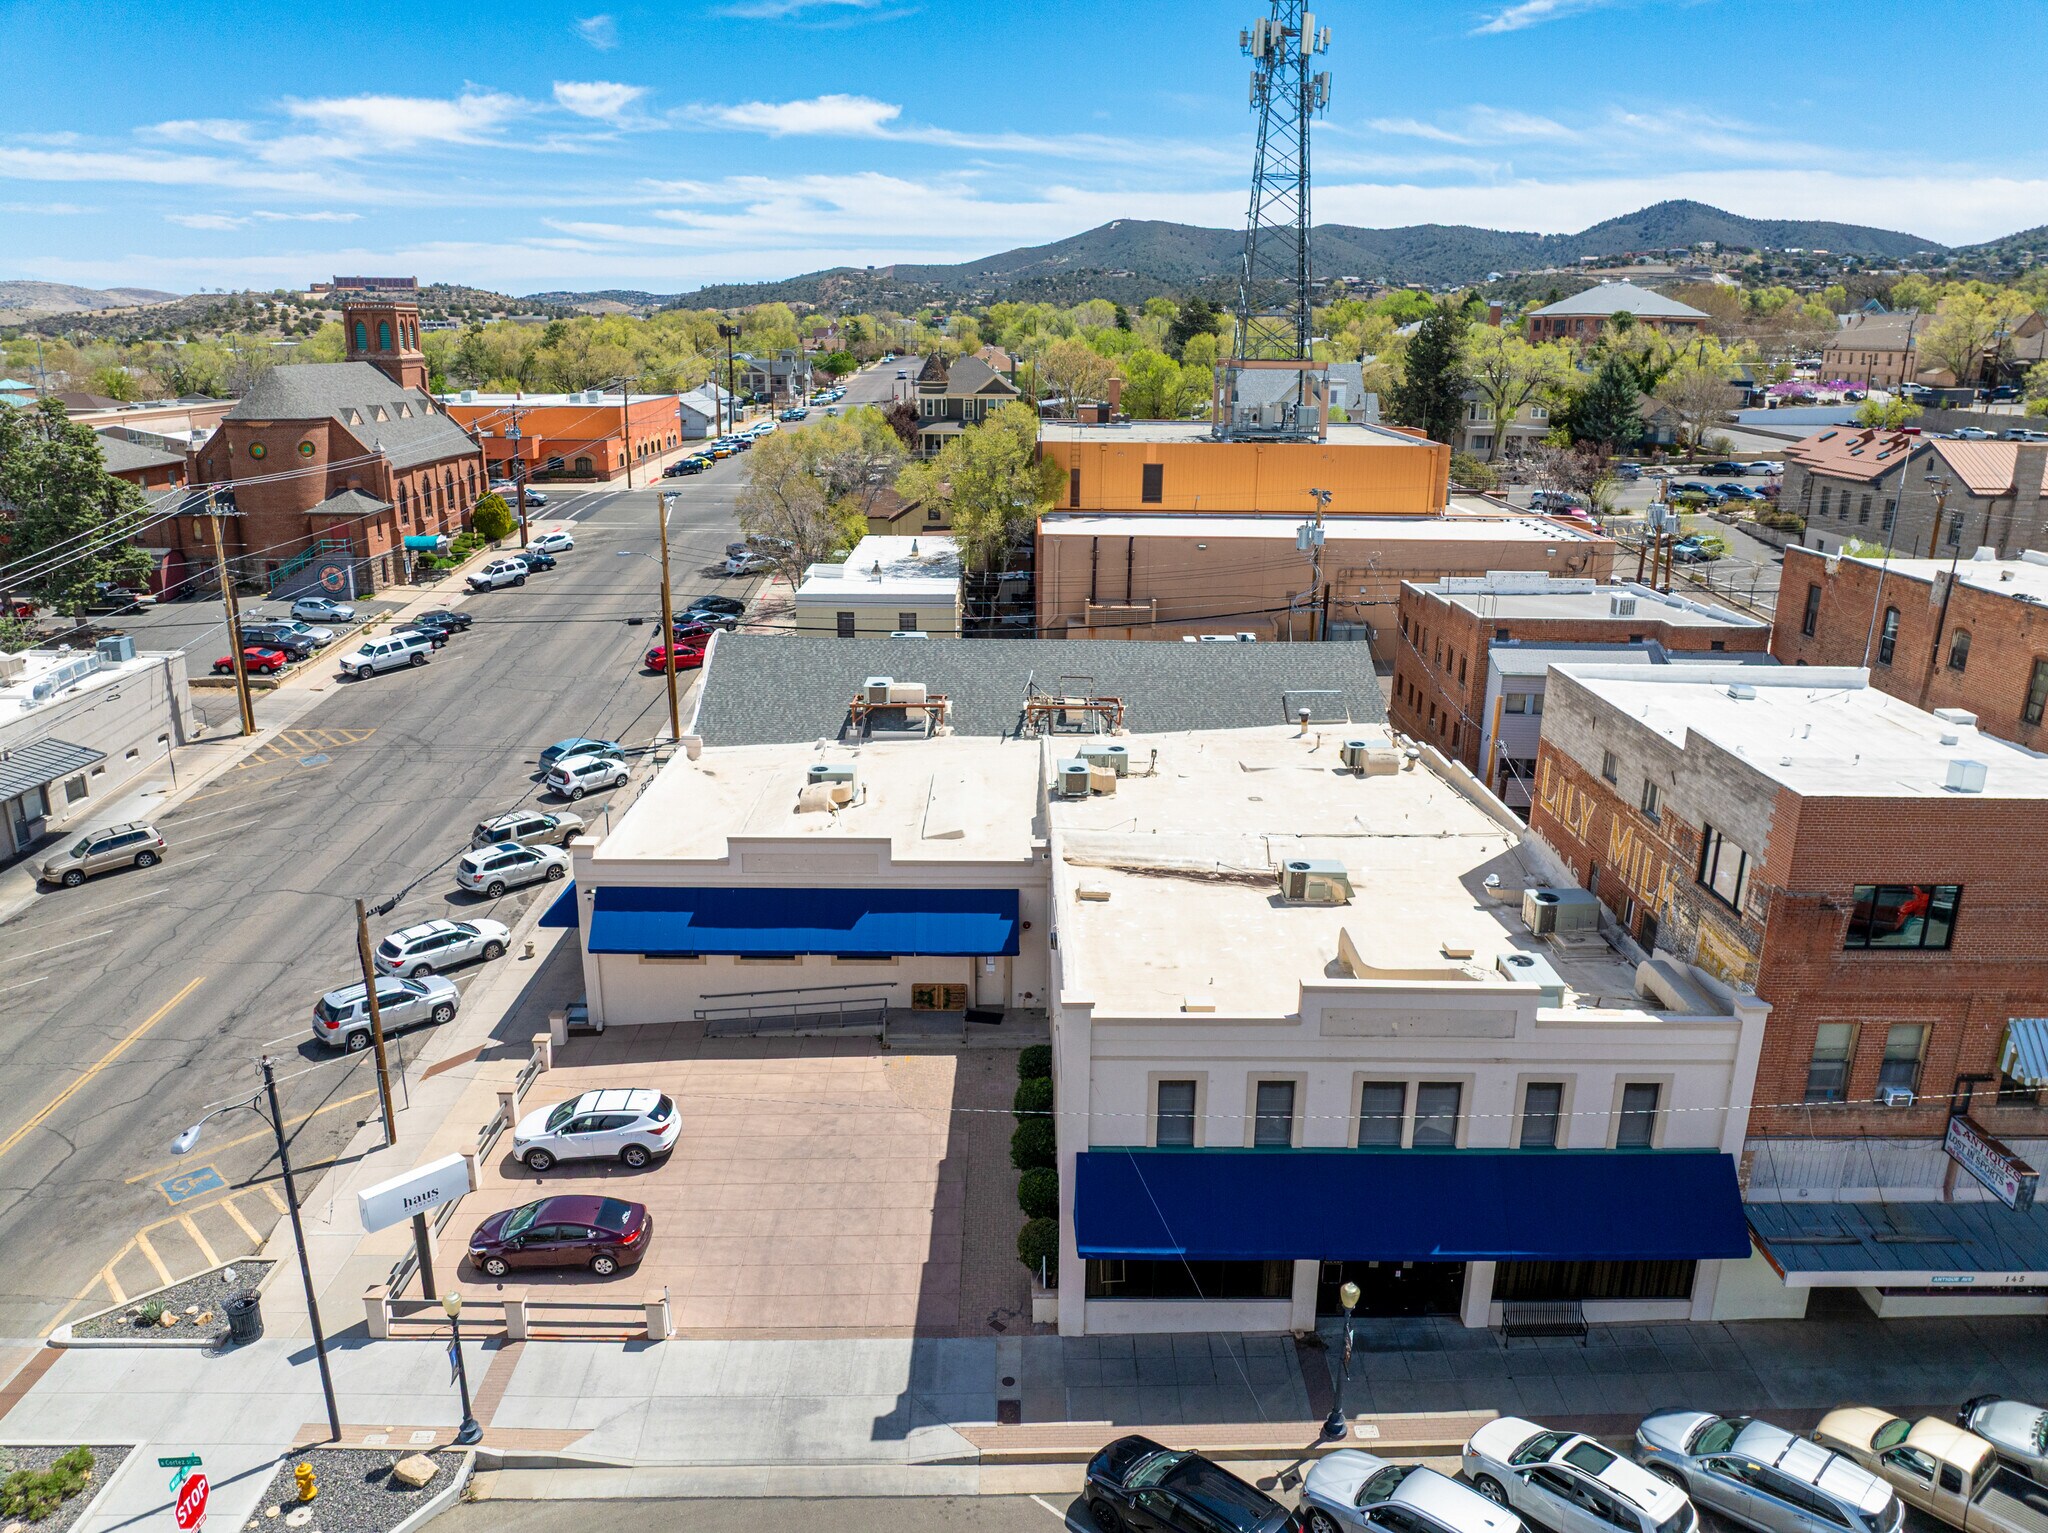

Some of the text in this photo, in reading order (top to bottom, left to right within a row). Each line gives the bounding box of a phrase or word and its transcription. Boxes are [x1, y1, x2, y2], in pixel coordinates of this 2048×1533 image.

[1540, 757, 1597, 847] LILY
[1606, 813, 1680, 927] MILK
[1948, 1132, 1967, 1154] LOST
[1966, 1148, 1975, 1160] IN
[1975, 1156, 2004, 1186] SPORTS
[1962, 1131, 2020, 1183] ANTIQUES
[403, 1188, 439, 1208] haus
[2005, 1275, 2025, 1283] 145
[177, 1478, 206, 1525] STOP
